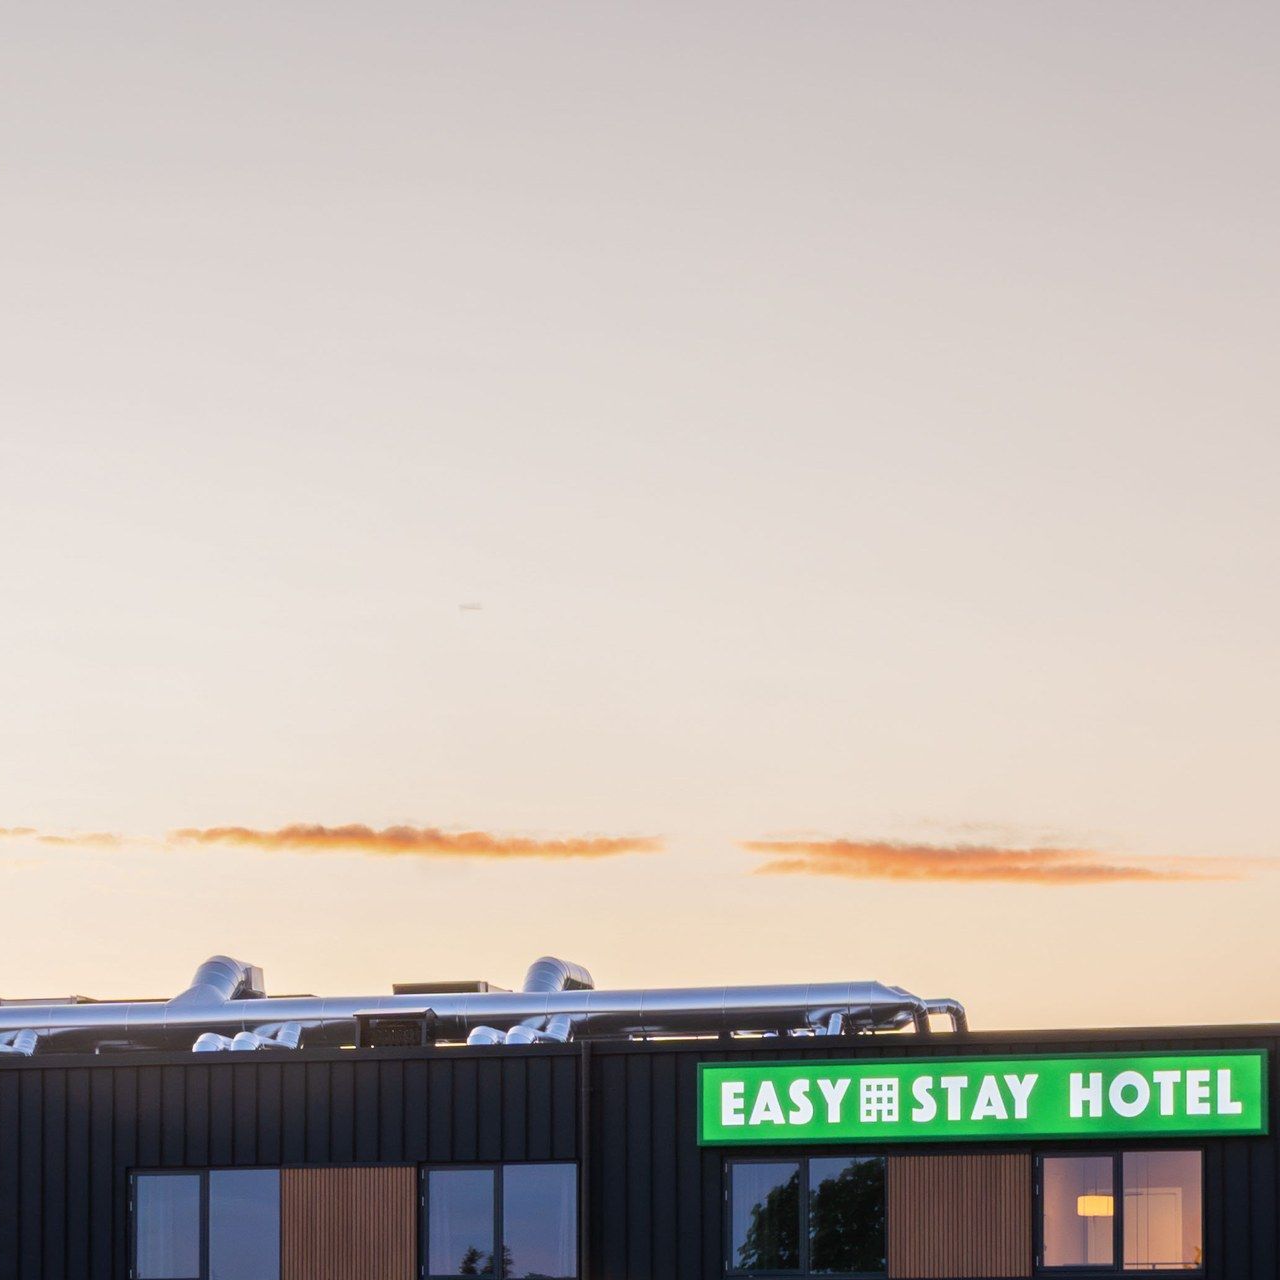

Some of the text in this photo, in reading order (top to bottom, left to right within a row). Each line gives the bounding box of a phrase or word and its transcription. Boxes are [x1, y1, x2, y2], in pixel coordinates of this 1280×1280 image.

[720, 1068, 1243, 1127] EASY STAY HOTEL
